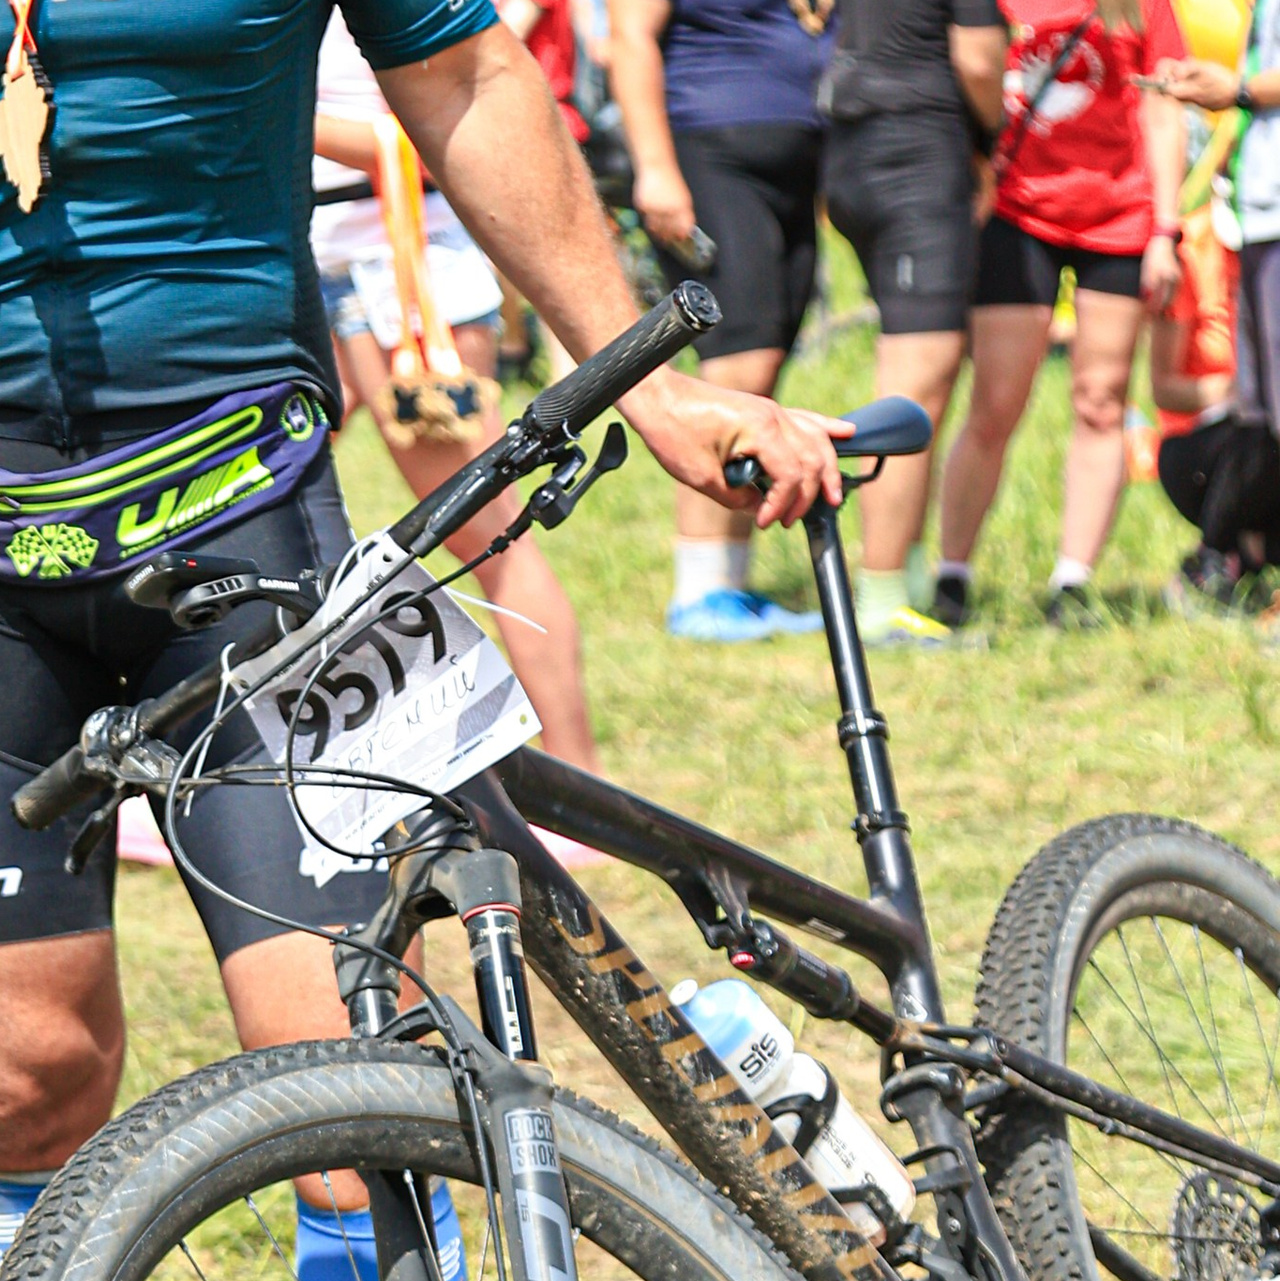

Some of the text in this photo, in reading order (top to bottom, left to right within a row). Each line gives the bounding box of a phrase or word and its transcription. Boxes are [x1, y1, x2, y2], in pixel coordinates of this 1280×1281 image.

[128, 564, 155, 589] GARMIN
[257, 577, 300, 592] GARMIN
[276, 590, 448, 763] 9579
[508, 1113, 555, 1141] ROCK
[515, 1142, 557, 1169] SHOX
